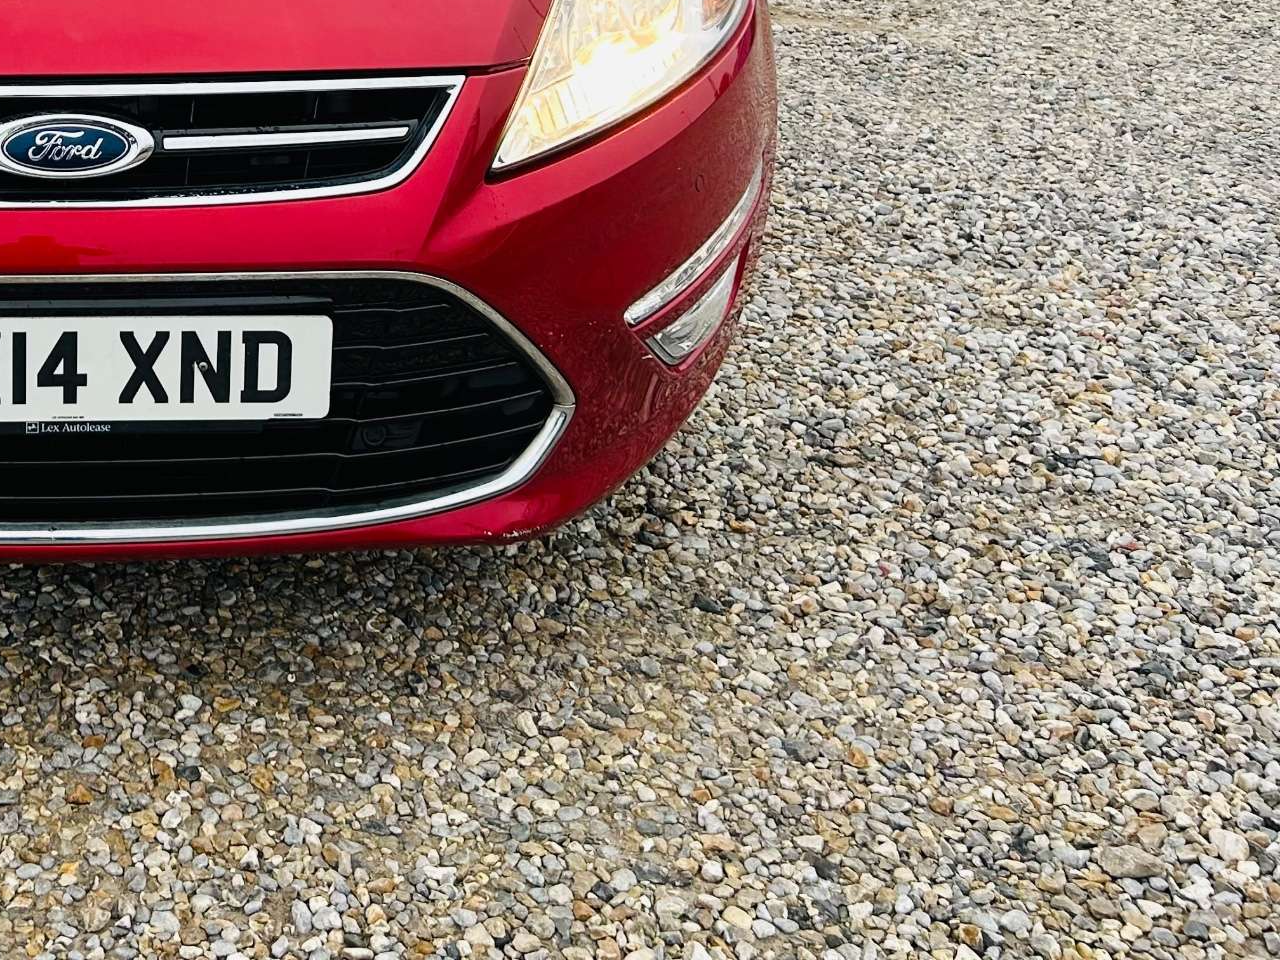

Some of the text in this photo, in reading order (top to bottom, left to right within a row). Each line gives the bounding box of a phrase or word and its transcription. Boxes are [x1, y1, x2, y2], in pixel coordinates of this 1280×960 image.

[27, 130, 104, 161] Ford
[119, 330, 293, 404] XND
[41, 422, 111, 433] Lex Autolease
